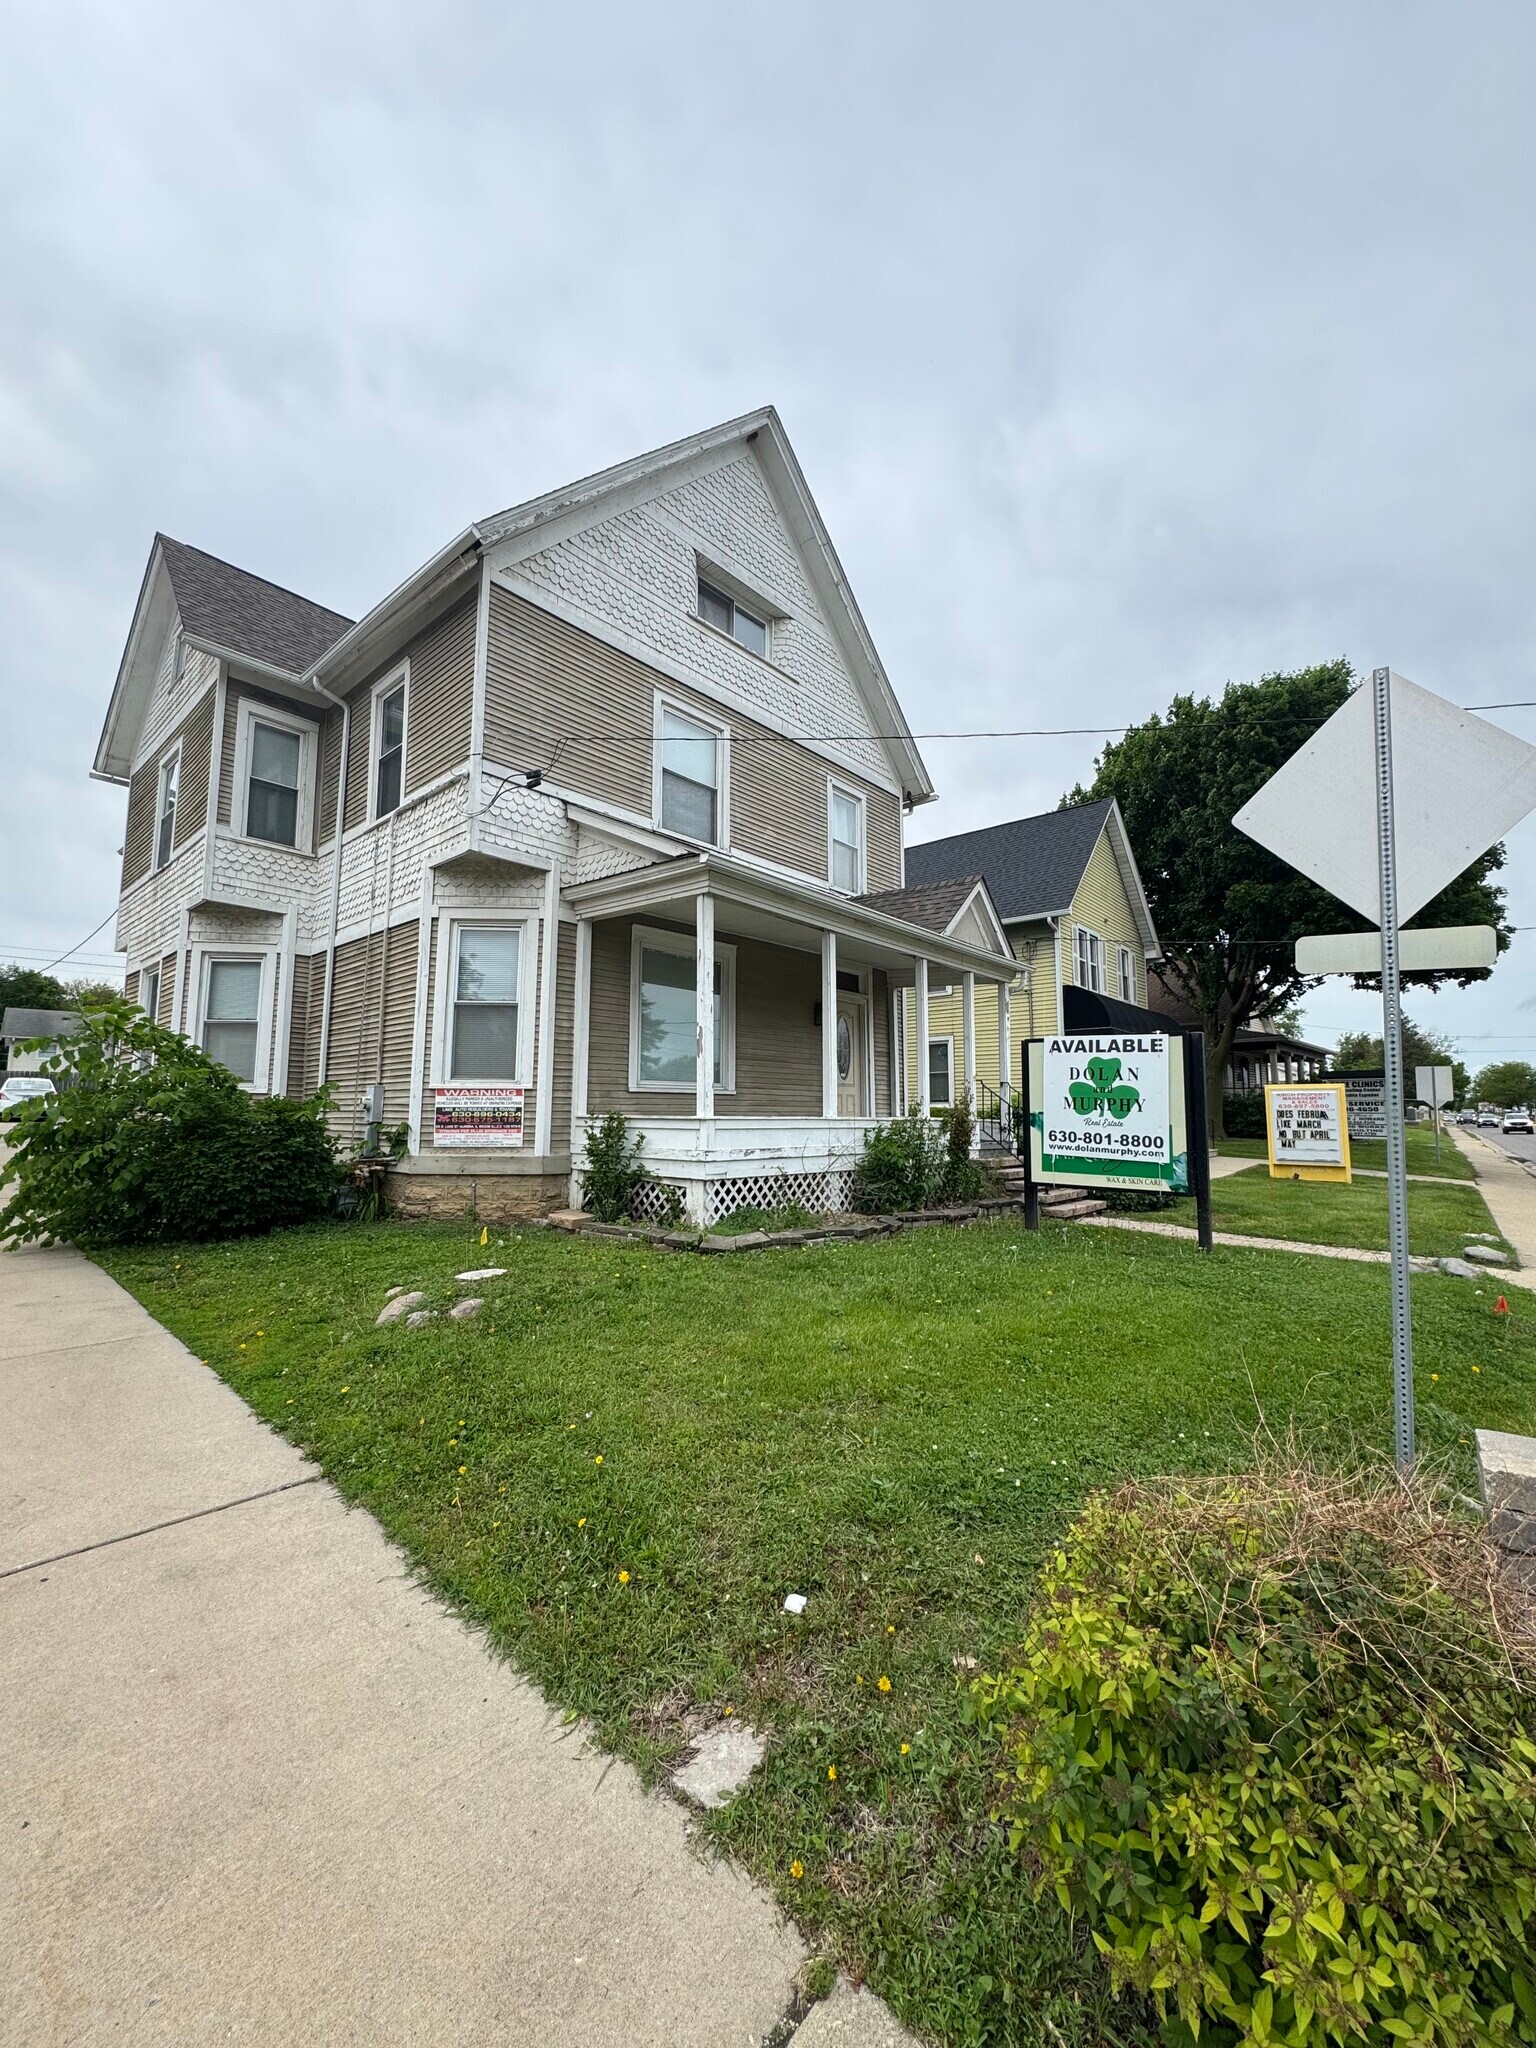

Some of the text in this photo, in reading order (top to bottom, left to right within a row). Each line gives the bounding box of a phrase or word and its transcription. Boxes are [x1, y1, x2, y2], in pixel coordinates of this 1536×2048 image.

[1049, 1038, 1163, 1054] AVAILABLE
[1069, 1067, 1139, 1082] DOLAN
[1352, 1080, 1385, 1088] CLINICS
[1093, 1085, 1113, 1094] and
[1064, 1097, 1146, 1113] MURPHY
[1276, 1110, 1293, 1119] DOES
[1084, 1118, 1124, 1128] Real Estate
[1276, 1120, 1321, 1129] LIKE MARCH
[1278, 1130, 1330, 1139] NO BUT APRIL
[1048, 1130, 1164, 1149] 630-801-8800
[1281, 1140, 1296, 1149] MAY
[1048, 1143, 1164, 1158] www.dolanmurphy.com
[1145, 1179, 1162, 1187] CARE
